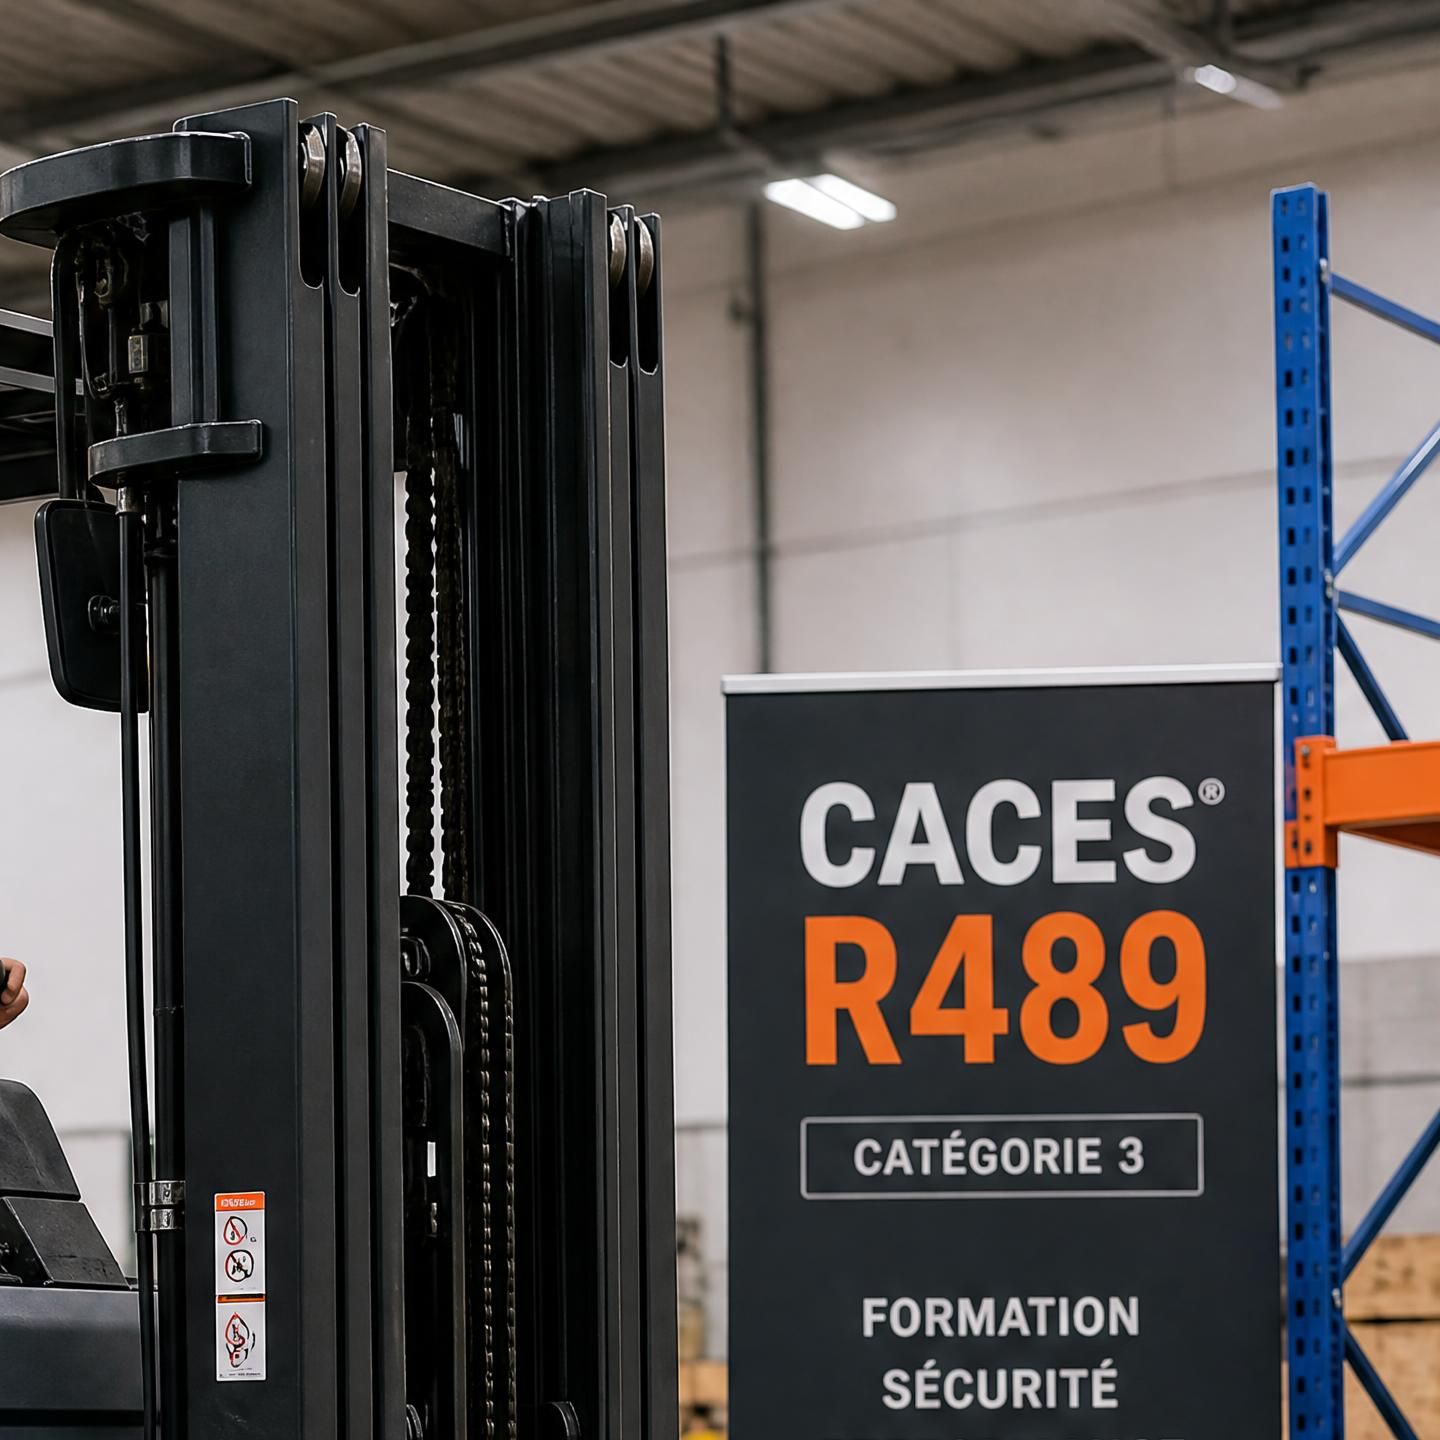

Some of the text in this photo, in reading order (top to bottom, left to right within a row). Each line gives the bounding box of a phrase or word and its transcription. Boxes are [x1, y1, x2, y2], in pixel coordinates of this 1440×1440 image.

[804, 909, 1208, 1066] R489
[853, 1131, 1145, 1176] CATÉGORIE 3
[862, 1296, 1140, 1338] FORMATION
[881, 1358, 1119, 1410] SÉCURITÉ
